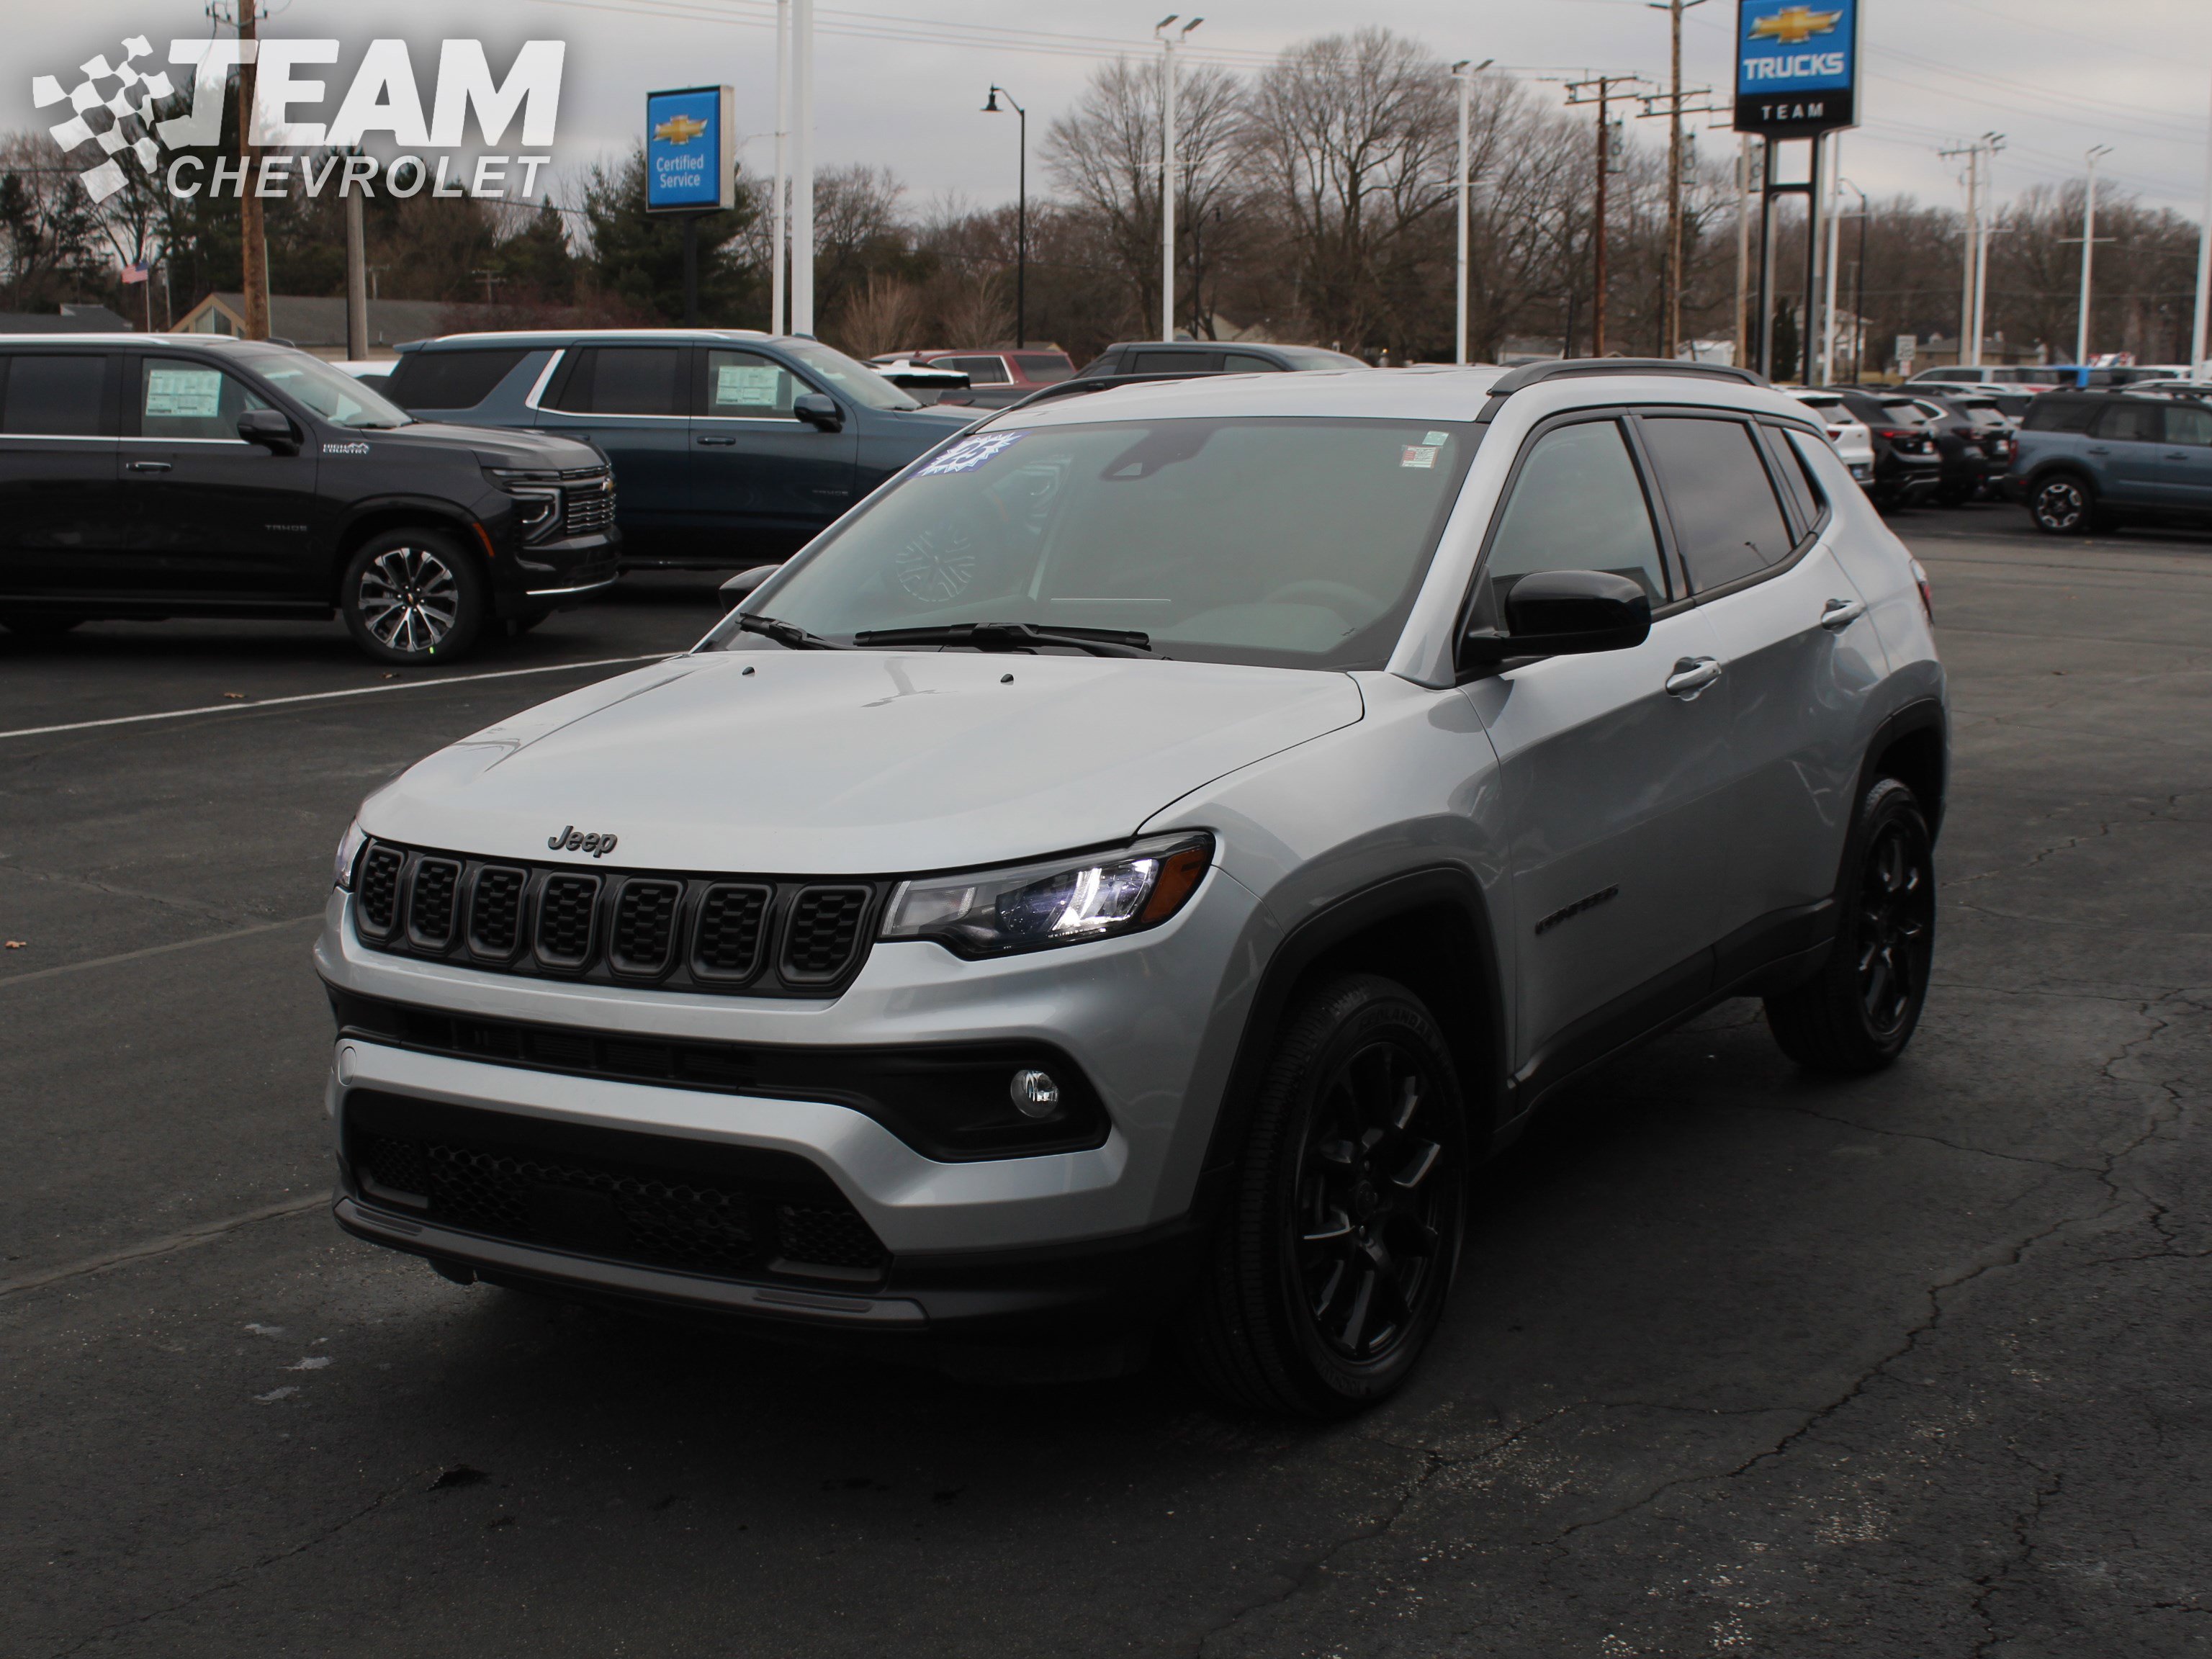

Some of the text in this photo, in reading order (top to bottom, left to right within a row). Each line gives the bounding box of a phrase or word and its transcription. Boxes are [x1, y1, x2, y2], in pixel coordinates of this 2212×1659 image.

[1743, 52, 1845, 81] TRUCKS
[1761, 102, 1824, 120] TEAM
[656, 154, 704, 171] Certified
[660, 172, 701, 189] Service
[548, 825, 618, 858] Jeep
